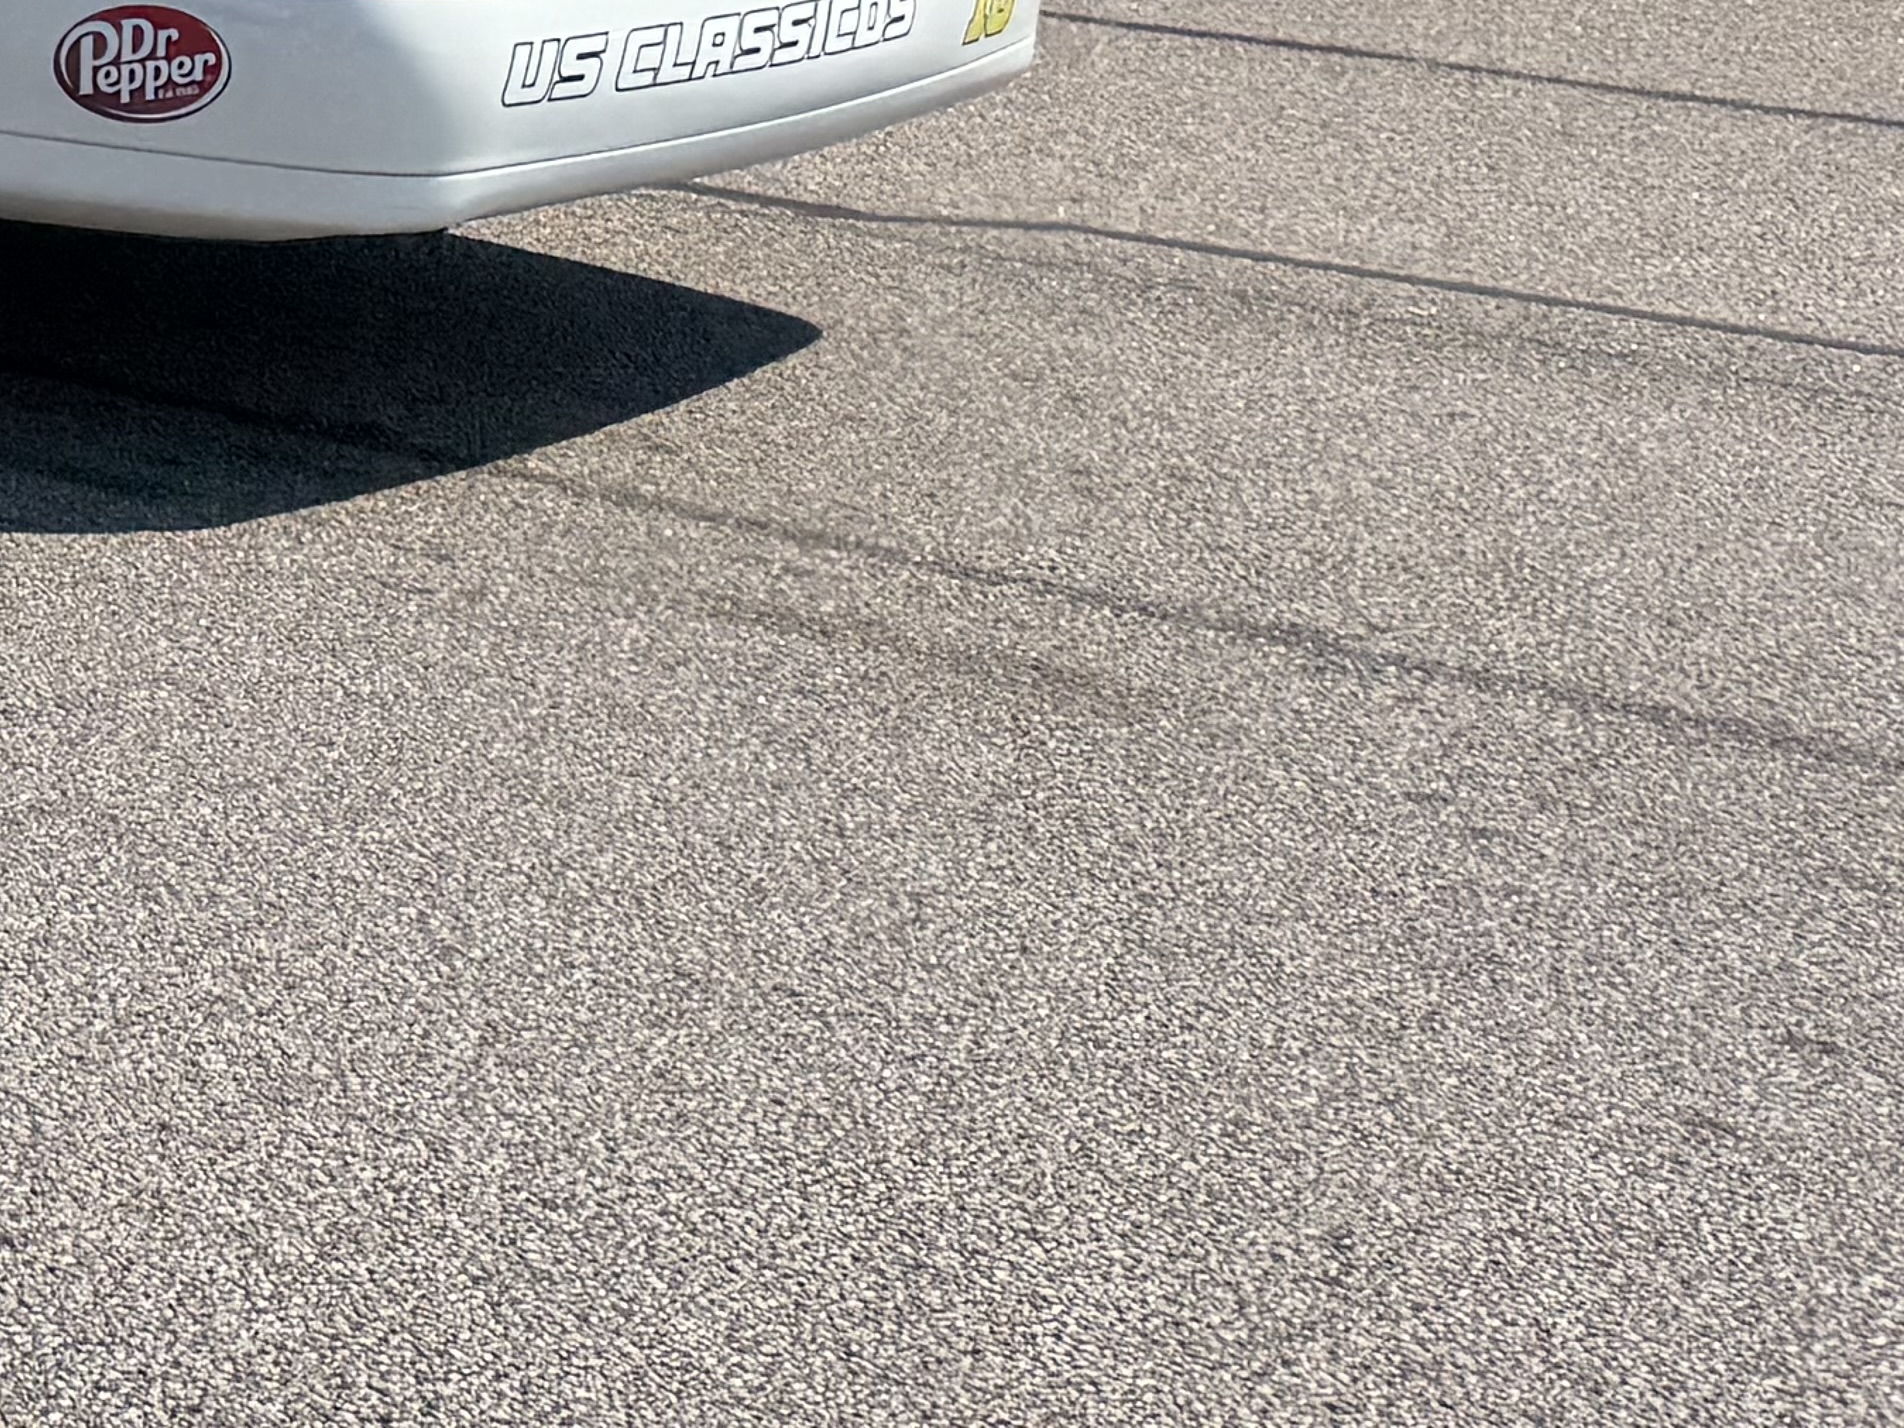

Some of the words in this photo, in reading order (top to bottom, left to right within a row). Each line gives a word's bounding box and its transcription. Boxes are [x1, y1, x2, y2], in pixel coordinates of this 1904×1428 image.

[58, 19, 217, 104] Pepper
[120, 17, 180, 63] Dr
[501, 31, 610, 108] US
